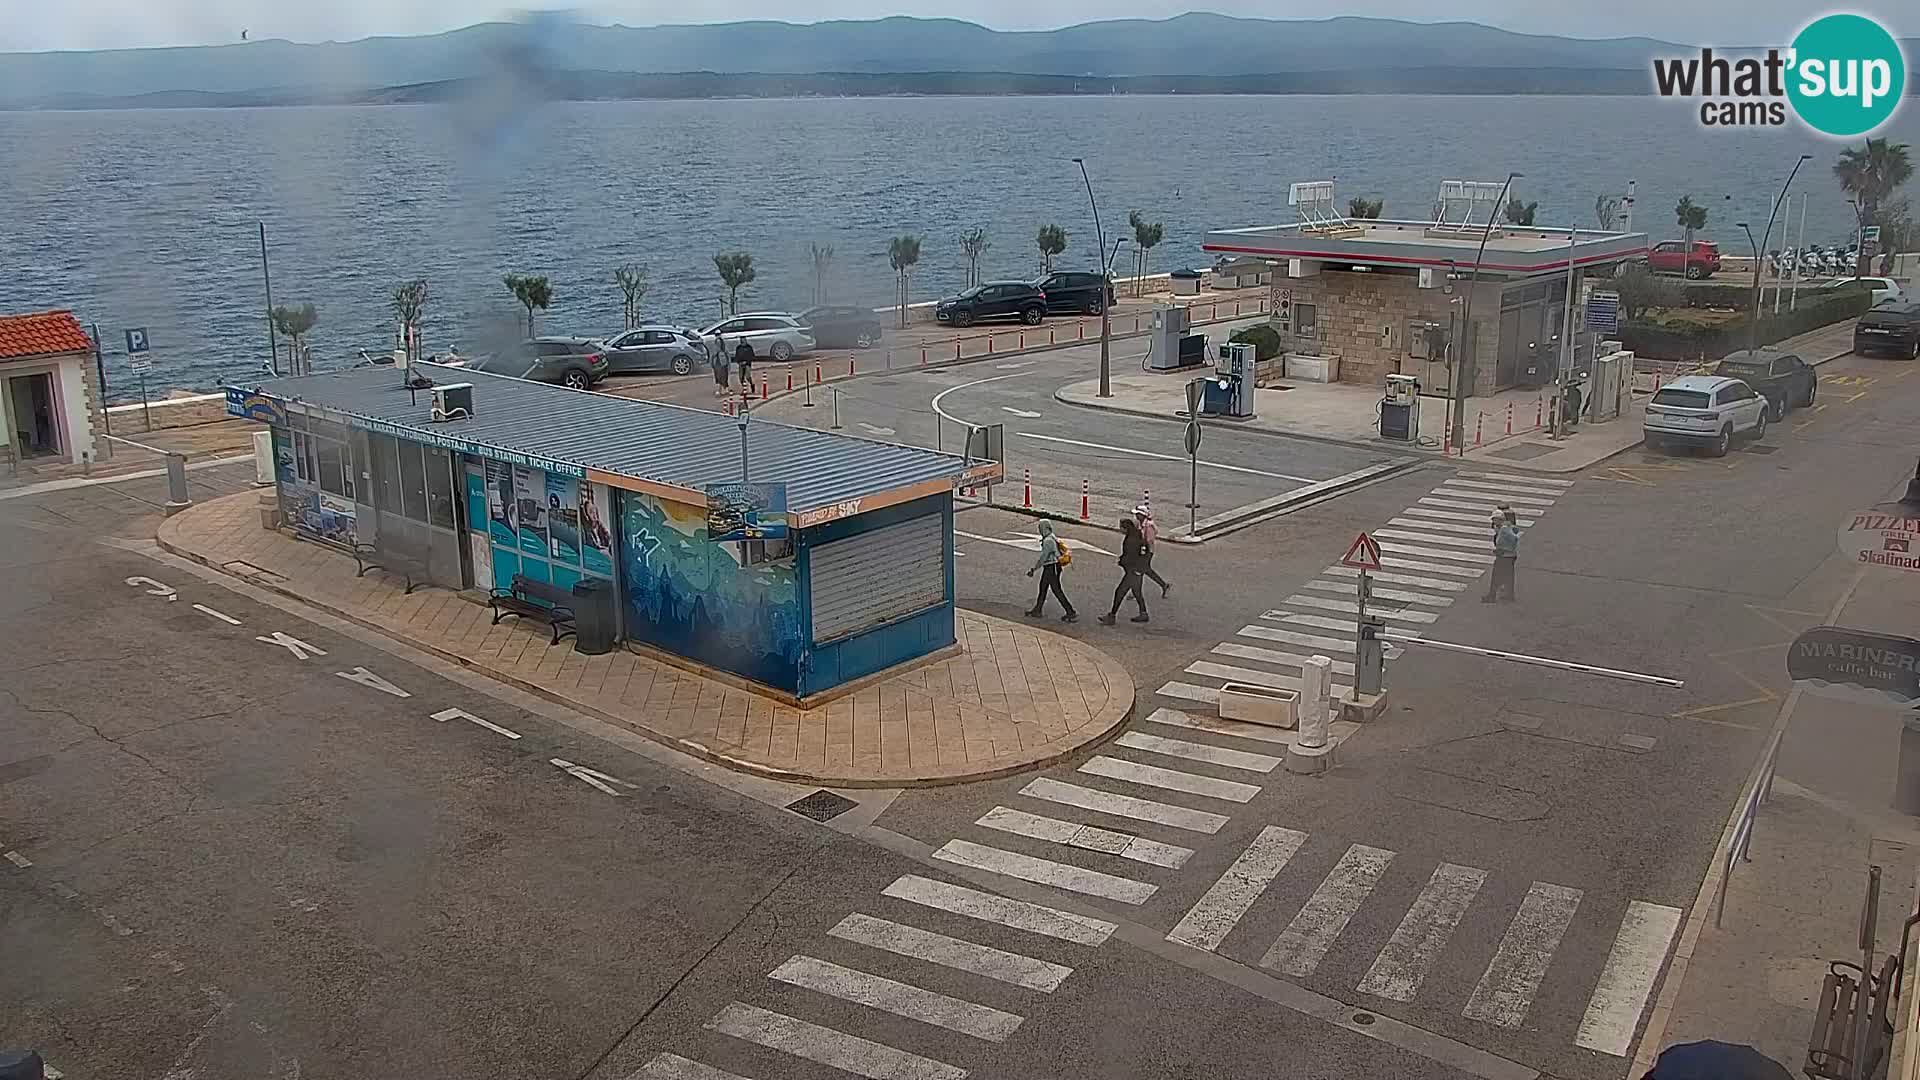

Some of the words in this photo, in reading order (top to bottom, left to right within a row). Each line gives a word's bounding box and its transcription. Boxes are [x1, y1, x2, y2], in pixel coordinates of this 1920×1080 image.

[130, 331, 144, 350] P
[437, 437, 468, 451] POSTAJA
[478, 445, 494, 457] BUS
[494, 449, 526, 465] STATION
[528, 456, 555, 471] TICKET
[555, 462, 583, 477] OFFICE
[1848, 515, 1920, 534] PIZZE
[1880, 530, 1917, 541] GRILL
[1869, 665, 1896, 680] bar
